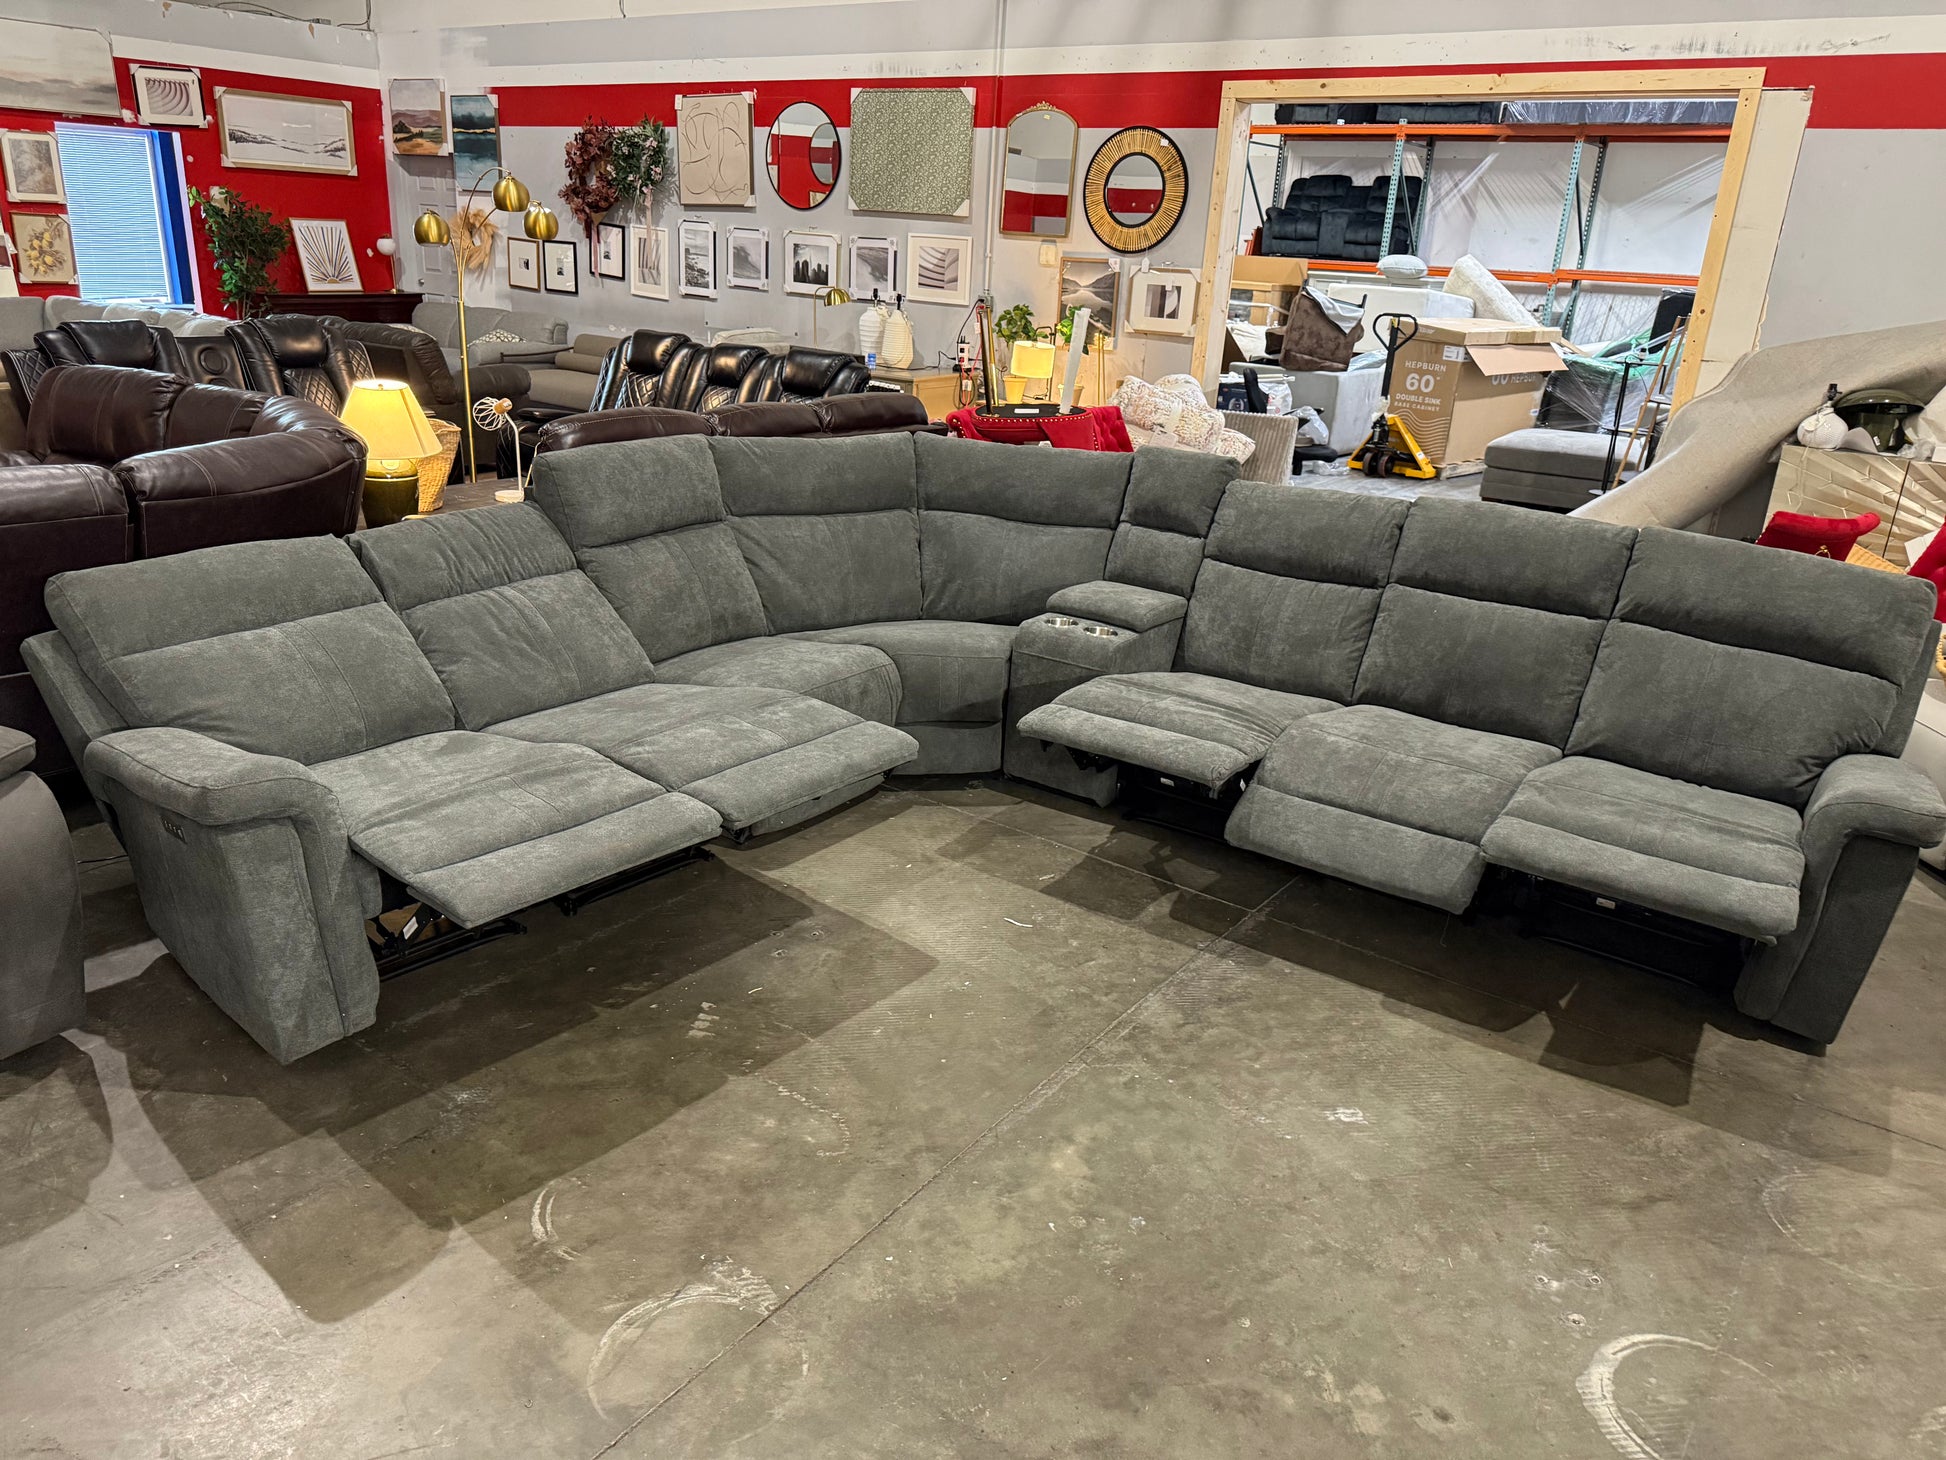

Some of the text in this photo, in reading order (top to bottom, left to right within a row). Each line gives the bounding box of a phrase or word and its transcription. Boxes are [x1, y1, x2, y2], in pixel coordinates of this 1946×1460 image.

[1405, 360, 1447, 372] HEPBURN
[1395, 393, 1441, 405] DOUBLE SINK
[1411, 403, 1441, 412] CABINET
